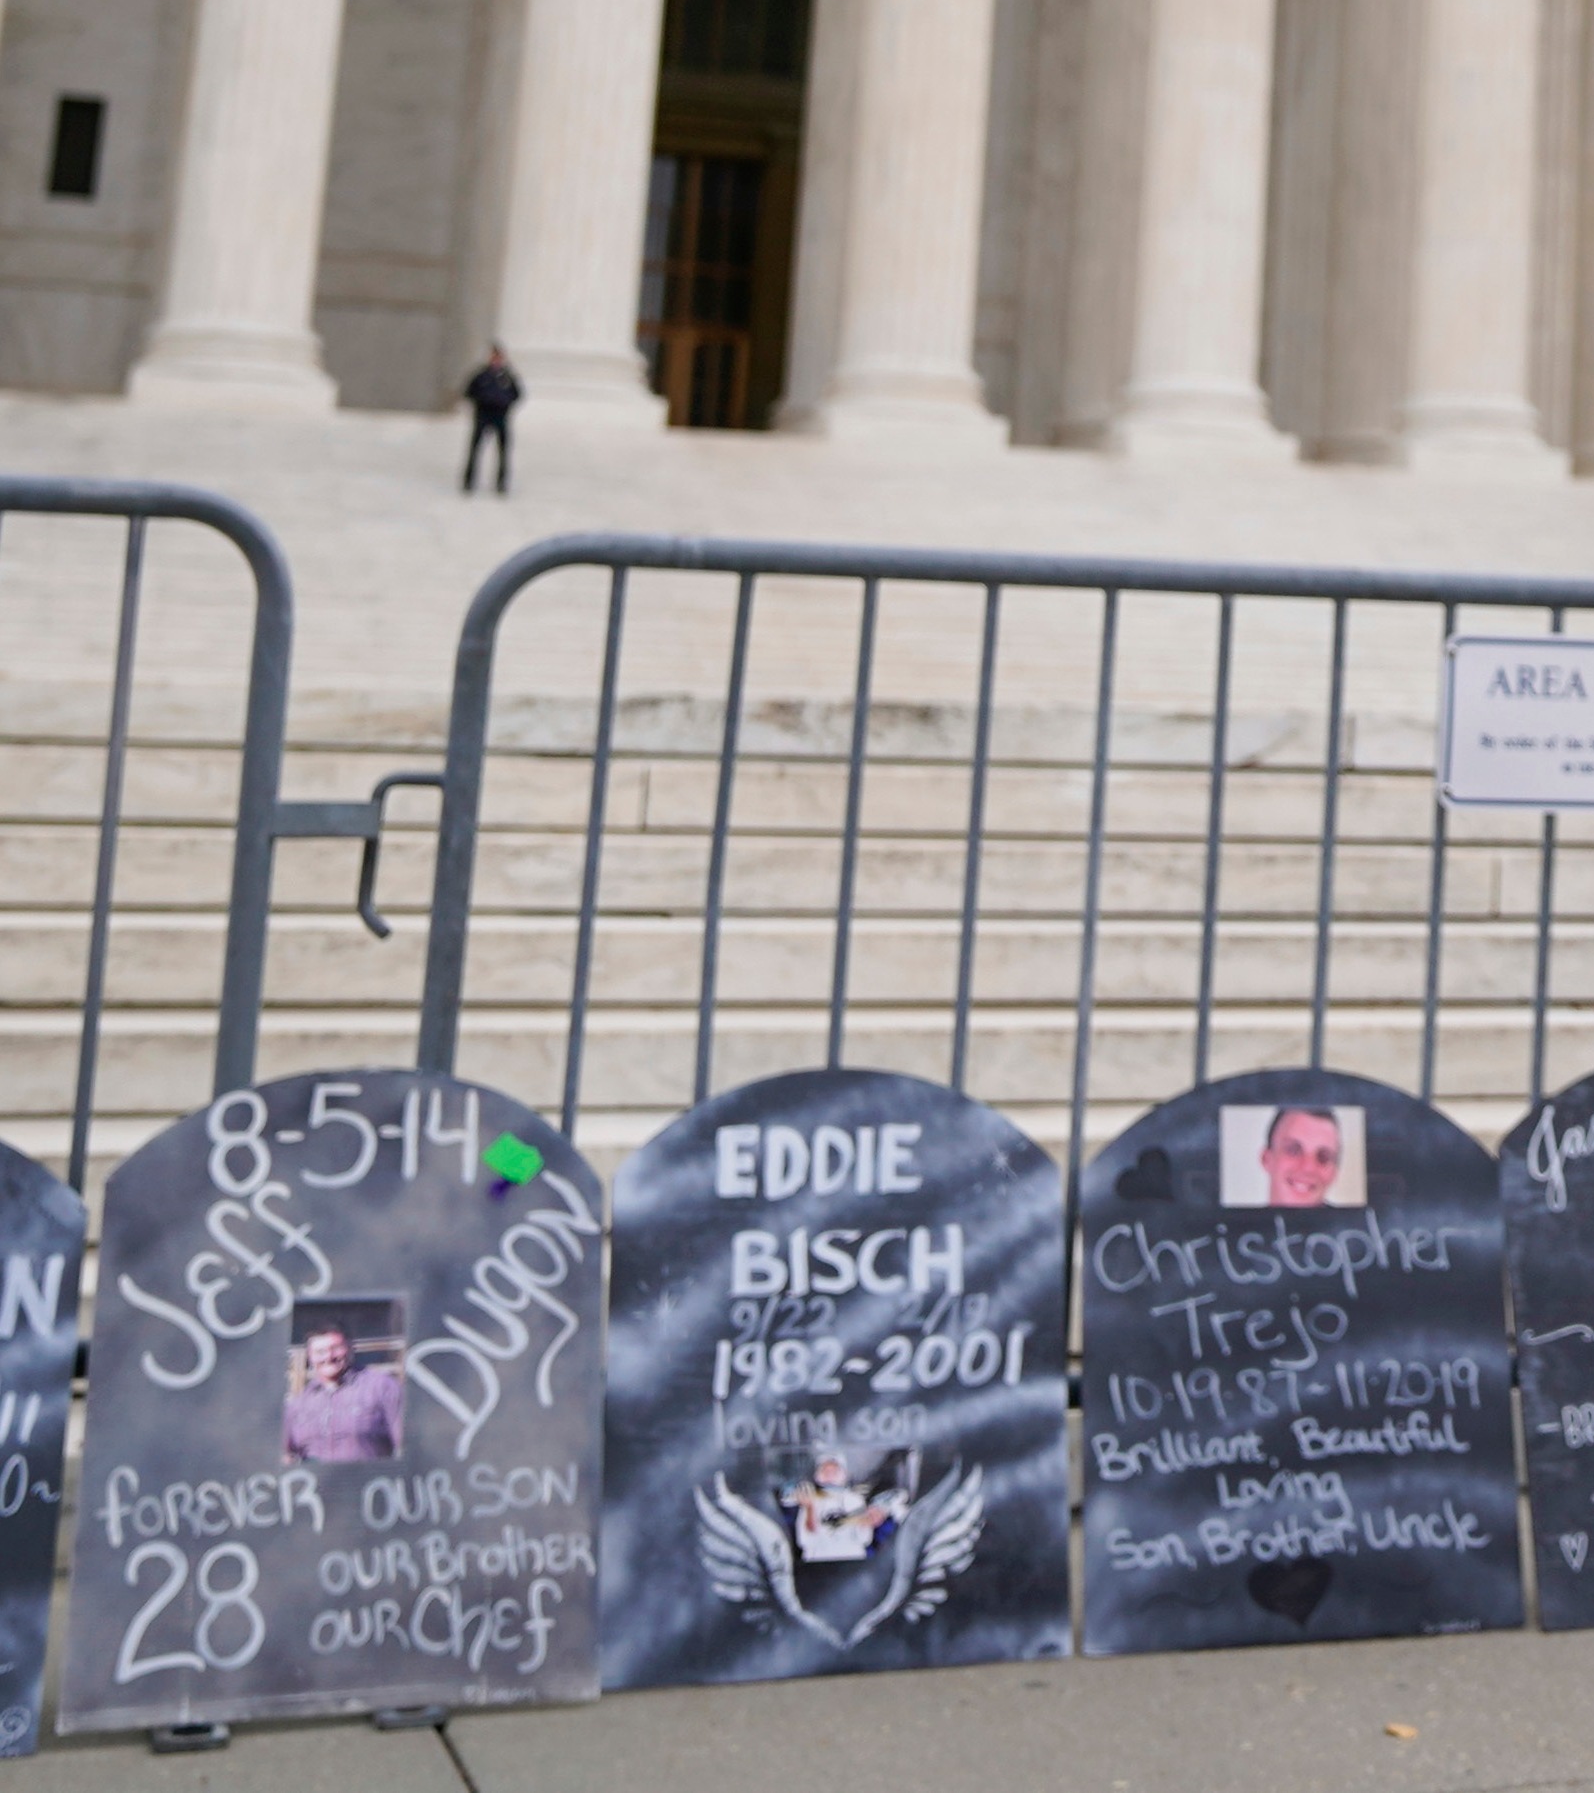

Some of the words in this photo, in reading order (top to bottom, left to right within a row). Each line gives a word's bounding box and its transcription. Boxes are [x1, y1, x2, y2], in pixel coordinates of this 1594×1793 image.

[1487, 663, 1587, 699] AREA
[206, 1082, 482, 1198] 8-5-14
[716, 1124, 923, 1201] EDDIE
[730, 1223, 965, 1298] BISCH
[1093, 1209, 1479, 1297] Christopher
[1151, 1293, 1349, 1371] Trejo
[713, 1399, 838, 1450] loving
[852, 1403, 928, 1441] son
[1293, 1410, 1470, 1461] Beautiful
[362, 1469, 462, 1530] OUR
[467, 1464, 579, 1513] SON
[1216, 1470, 1352, 1527] Loving
[1362, 1500, 1492, 1553] Uncle
[320, 1548, 418, 1597] OUR
[114, 1543, 266, 1685] 28
[310, 1603, 410, 1654] OUR
